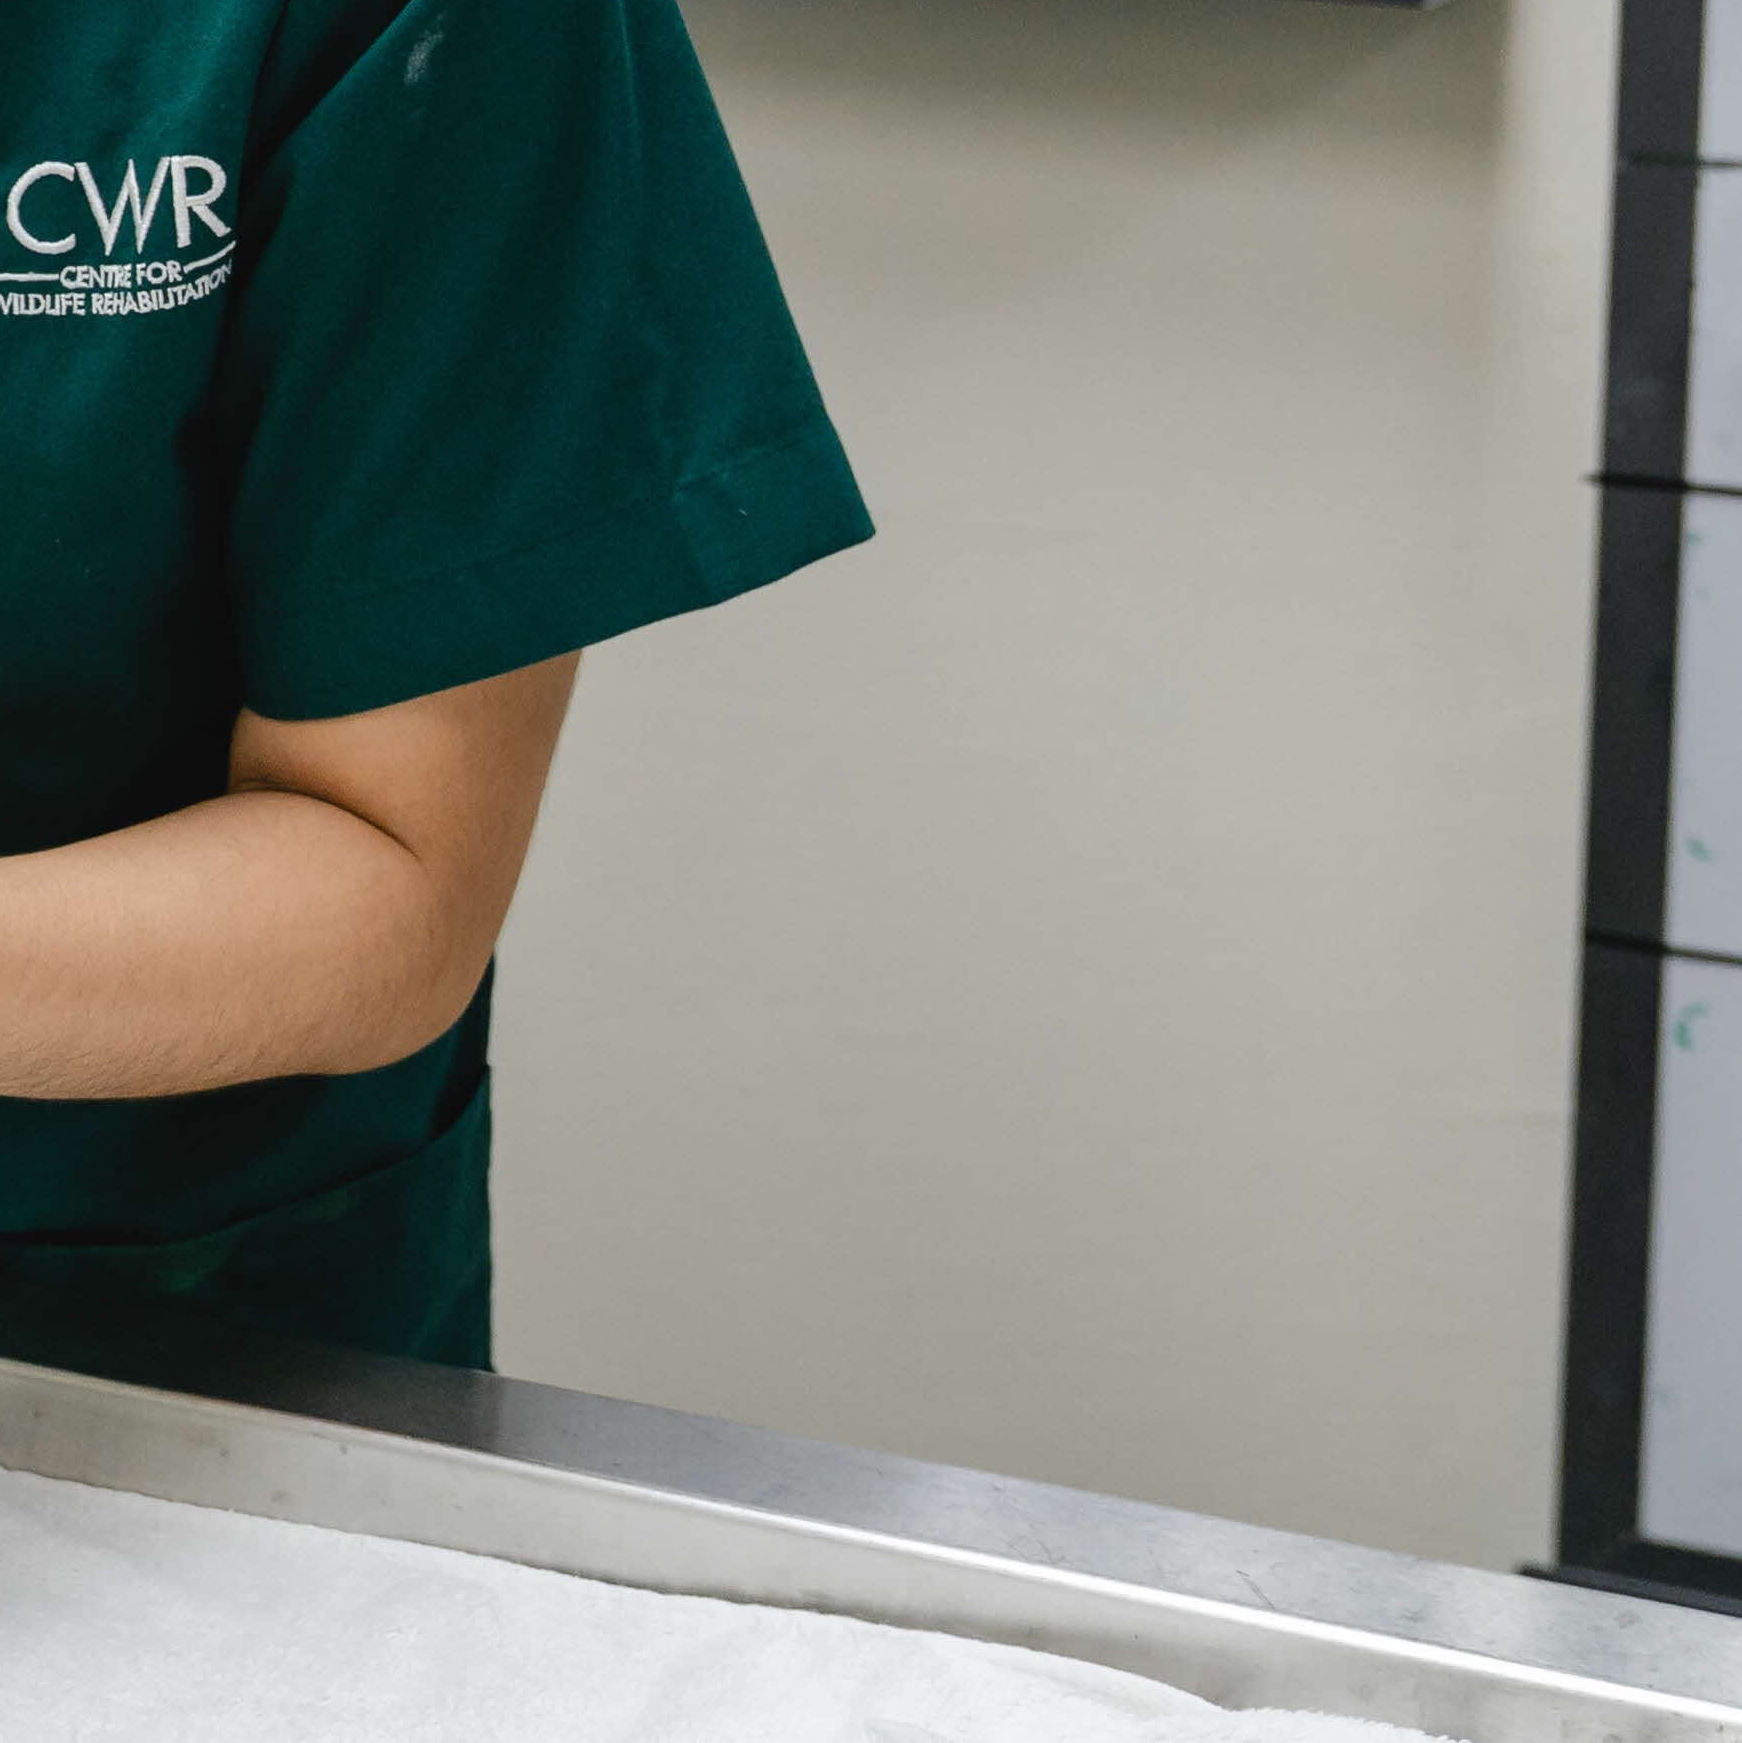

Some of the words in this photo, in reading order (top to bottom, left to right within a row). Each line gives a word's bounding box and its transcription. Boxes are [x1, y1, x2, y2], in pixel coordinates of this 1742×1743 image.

[6, 154, 234, 256] CWR
[59, 262, 133, 290] CENTRE
[136, 259, 184, 286] FOR
